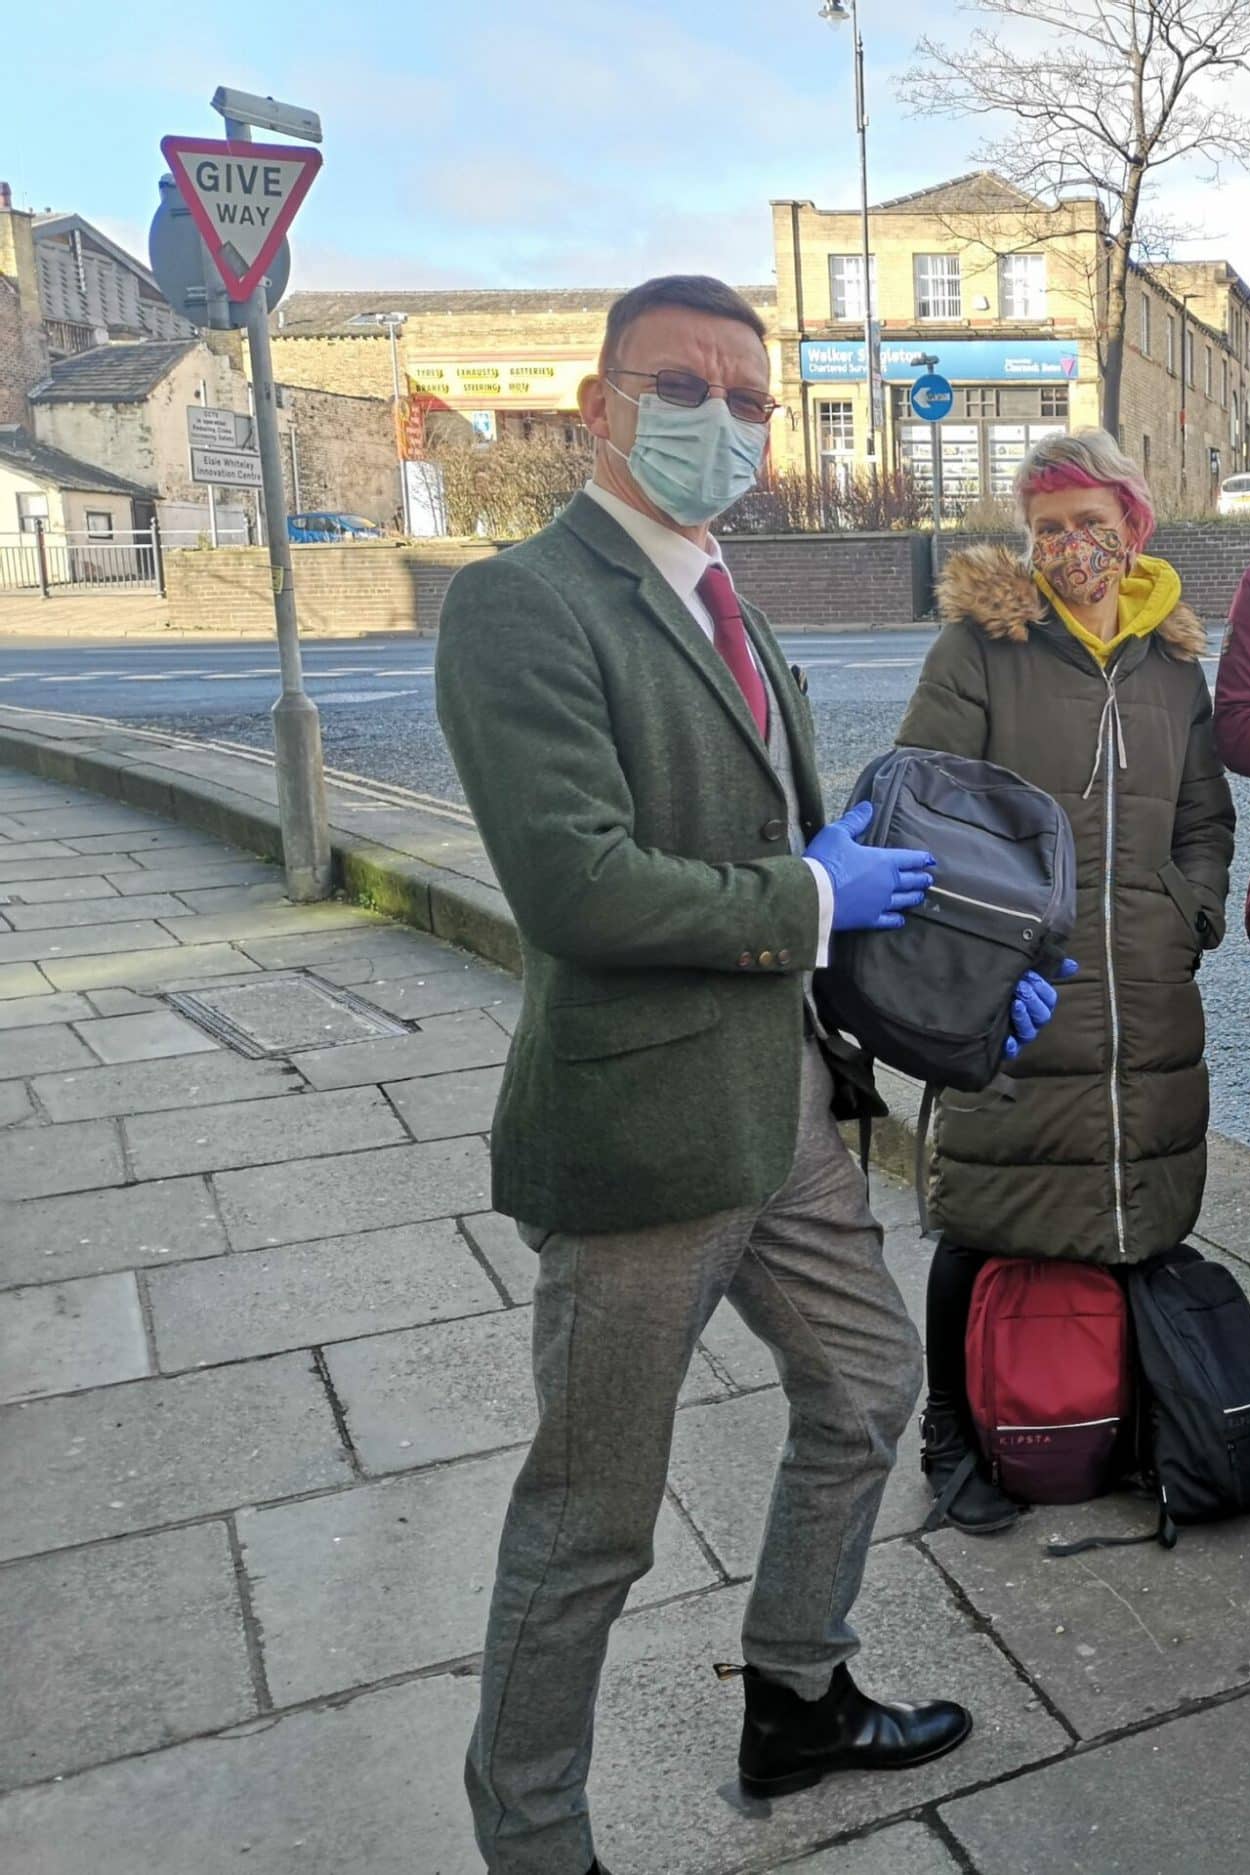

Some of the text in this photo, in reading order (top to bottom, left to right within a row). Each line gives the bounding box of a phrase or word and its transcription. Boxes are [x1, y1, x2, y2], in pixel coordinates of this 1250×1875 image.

[196, 161, 282, 197] GIVE
[216, 203, 270, 226] WAY
[808, 348, 922, 364] Walker Sgleton
[456, 368, 495, 377] EXHAUSTS
[510, 367, 550, 376] BATTERIES
[848, 363, 887, 373] Survrs
[463, 383, 496, 393] STEERING
[203, 455, 254, 471] Elsie Whiteley
[196, 467, 237, 478] Innovation
[1000, 1435, 1051, 1446] KIPSTA
